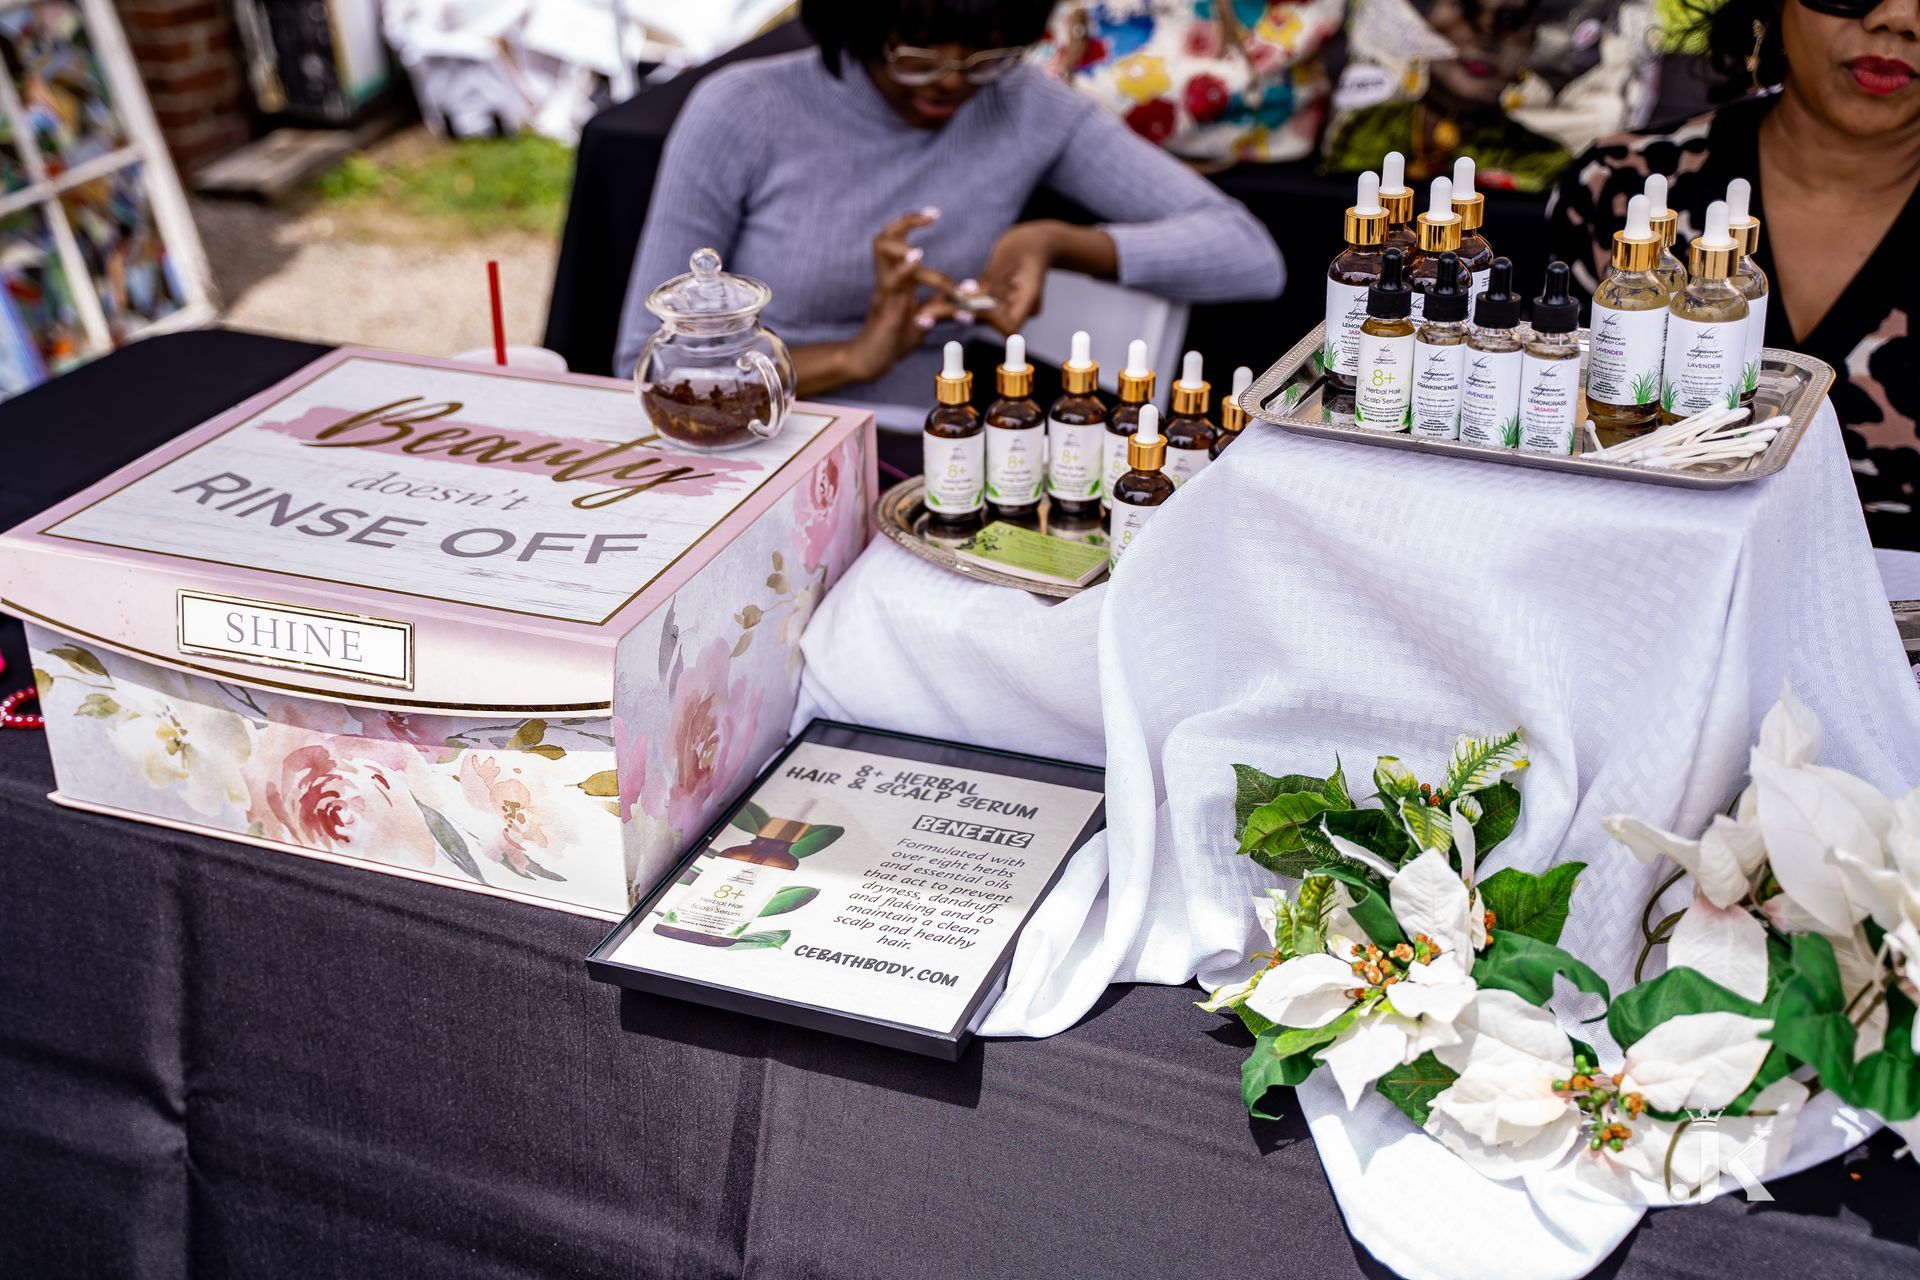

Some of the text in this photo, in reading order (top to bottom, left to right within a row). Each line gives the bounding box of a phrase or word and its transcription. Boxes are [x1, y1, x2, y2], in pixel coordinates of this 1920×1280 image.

[1596, 346, 1624, 356] LAVENDER
[1365, 386, 1387, 395] Herbal
[1372, 369, 1396, 387] 8+
[1417, 382, 1458, 391] FRANKINCENSE
[1363, 394, 1403, 405] Scalp Serum
[1466, 389, 1494, 399] LAVENDER
[1527, 397, 1567, 407] LEMONGRASS
[300, 397, 715, 509] Beauty
[347, 470, 531, 511] doesn't
[173, 472, 647, 564] RINSE OFF
[225, 611, 364, 663] SHINE
[785, 766, 1039, 820] HAIR & SCALP SERUM
[856, 765, 980, 795] 8+ HERBAL
[914, 815, 1034, 848] BENEFITS
[892, 851, 1016, 878] over eight herbs
[897, 838, 1026, 868] Formulated with
[864, 868, 1013, 904] that act to prevent
[880, 859, 1012, 890] and essential oils
[700, 896, 744, 909] Herbal Hair
[713, 884, 745, 899] 8+
[861, 881, 1004, 914] dryness, dandruff
[691, 902, 715, 913] Scalp
[715, 907, 741, 917] Serum
[846, 903, 980, 936] maintain a clean
[849, 890, 995, 926] and flaking and to
[833, 914, 977, 950] scalp and healthy
[876, 935, 911, 950] hair.
[794, 944, 960, 987] CEBATHBODY.COM
